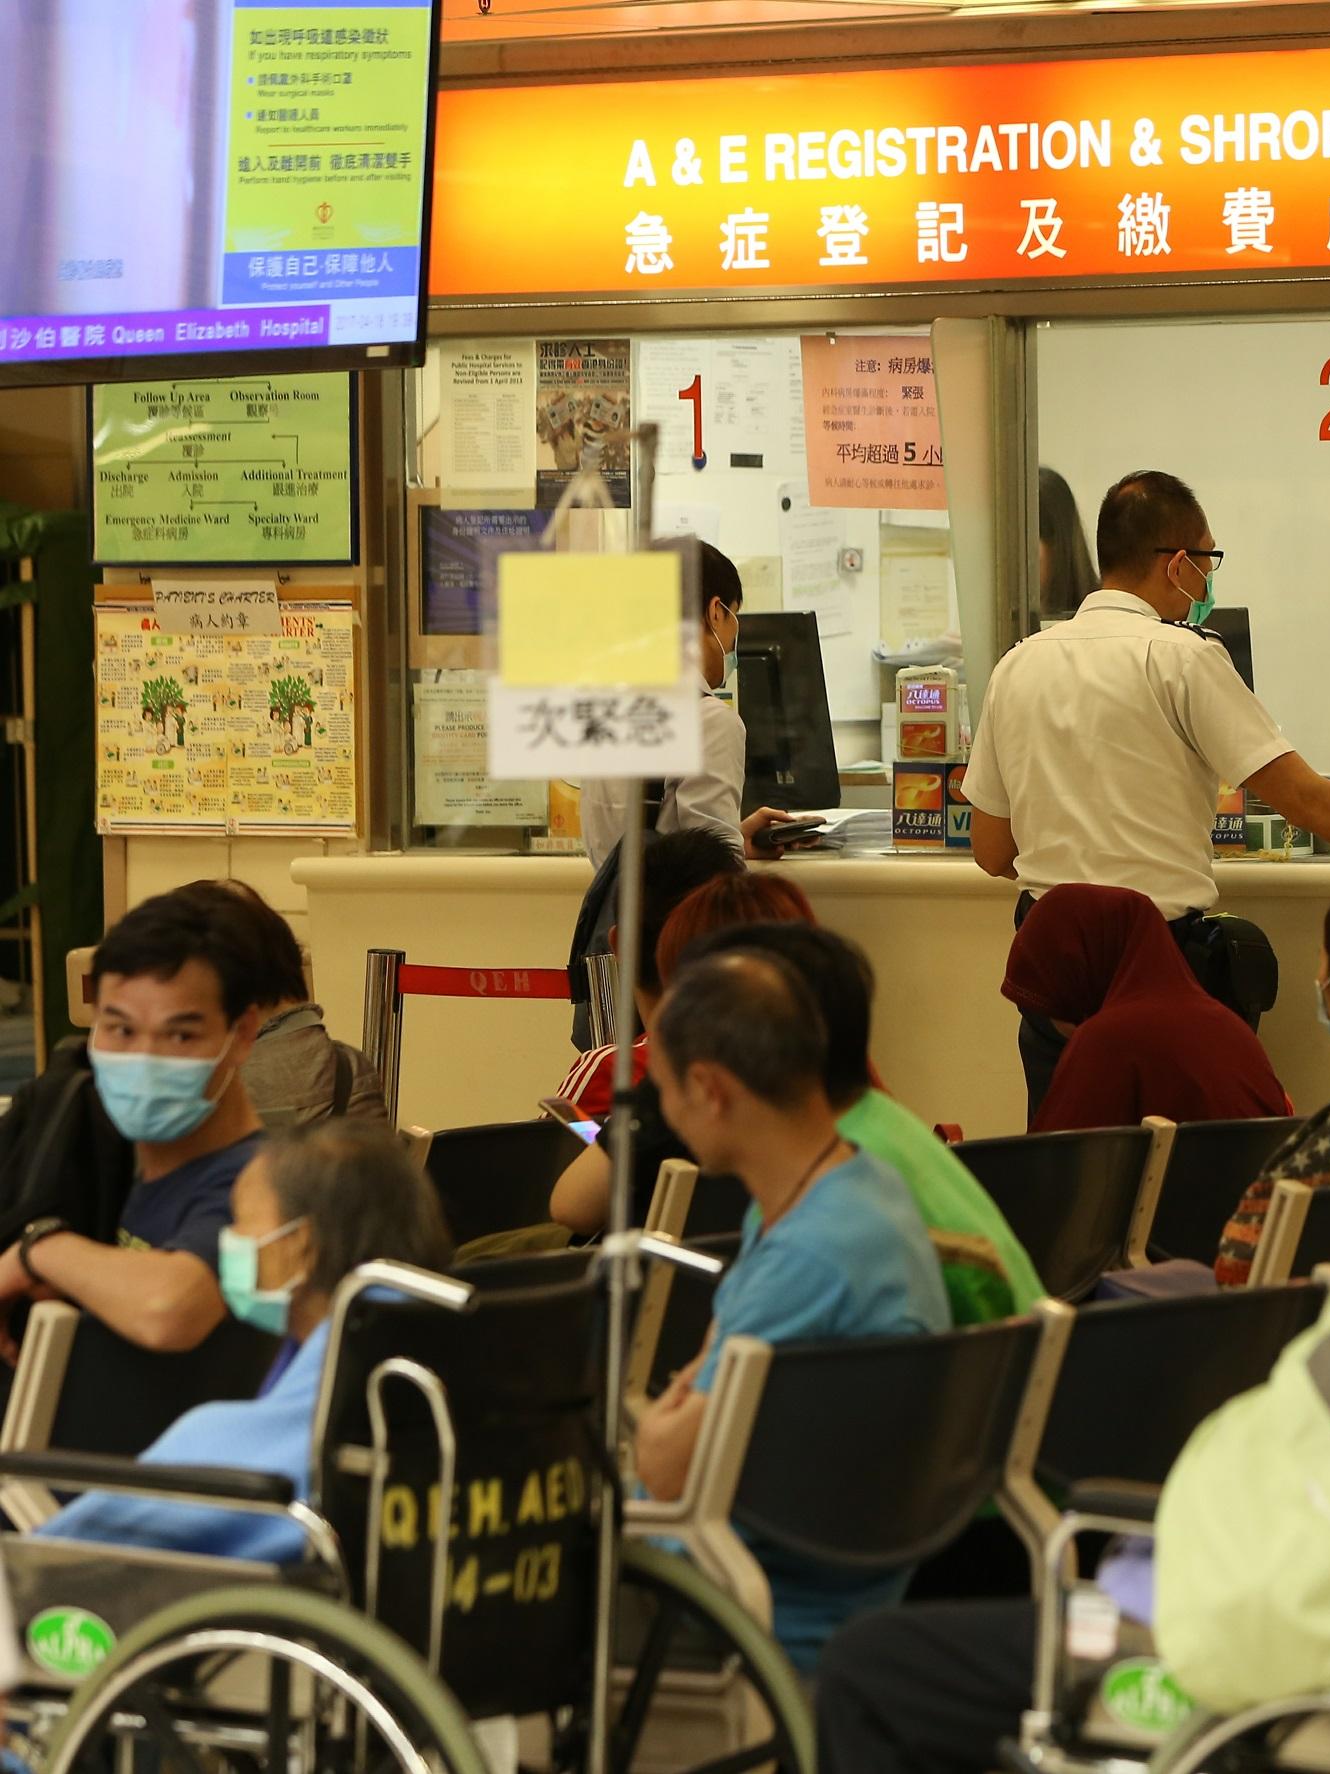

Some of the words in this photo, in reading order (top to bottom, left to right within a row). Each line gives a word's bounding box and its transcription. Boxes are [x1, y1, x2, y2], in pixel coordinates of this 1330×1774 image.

[624, 139, 656, 188] A
[671, 137, 704, 186] &
[720, 135, 748, 184] E
[764, 119, 1111, 181] REGISTRATION
[1129, 117, 1163, 168] &
[112, 326, 164, 344] Queen
[175, 320, 250, 341] Elizabeth
[260, 317, 324, 339] Hospital
[540, 343, 596, 358] 求診人士
[481, 354, 502, 362] Charges
[451, 362, 468, 370] Public
[469, 362, 492, 370] Hospital
[888, 357, 934, 374] 病房爆
[455, 370, 488, 378] Non-Eligible
[494, 378, 509, 386] April
[133, 391, 166, 403] Follow
[170, 392, 184, 405] Up
[187, 391, 210, 402] Area
[230, 390, 290, 401] Observation
[293, 390, 320, 401] Room
[901, 385, 924, 400] 緊張
[679, 374, 703, 458] 1
[836, 443, 899, 465] 平均超過
[904, 441, 917, 463] 5
[922, 444, 943, 465] 小
[100, 471, 149, 483] Discharge
[168, 470, 219, 481] Admission
[241, 469, 294, 481] Additional
[296, 470, 348, 480] Treatment
[105, 514, 157, 527] Emergency
[159, 514, 201, 524] Medicine
[203, 514, 230, 524] Ward
[248, 513, 290, 527] Specialty
[291, 513, 319, 524] Ward
[156, 591, 215, 604] PATIENT'S
[218, 591, 276, 605] CHARTER
[907, 689, 941, 700] 八達通
[514, 691, 676, 750] 次緊急
[897, 812, 943, 827] 八達通
[953, 812, 972, 831] VI
[1214, 816, 1243, 831] 達通
[469, 970, 531, 995] QEH
[445, 1543, 561, 1614] 4-03
